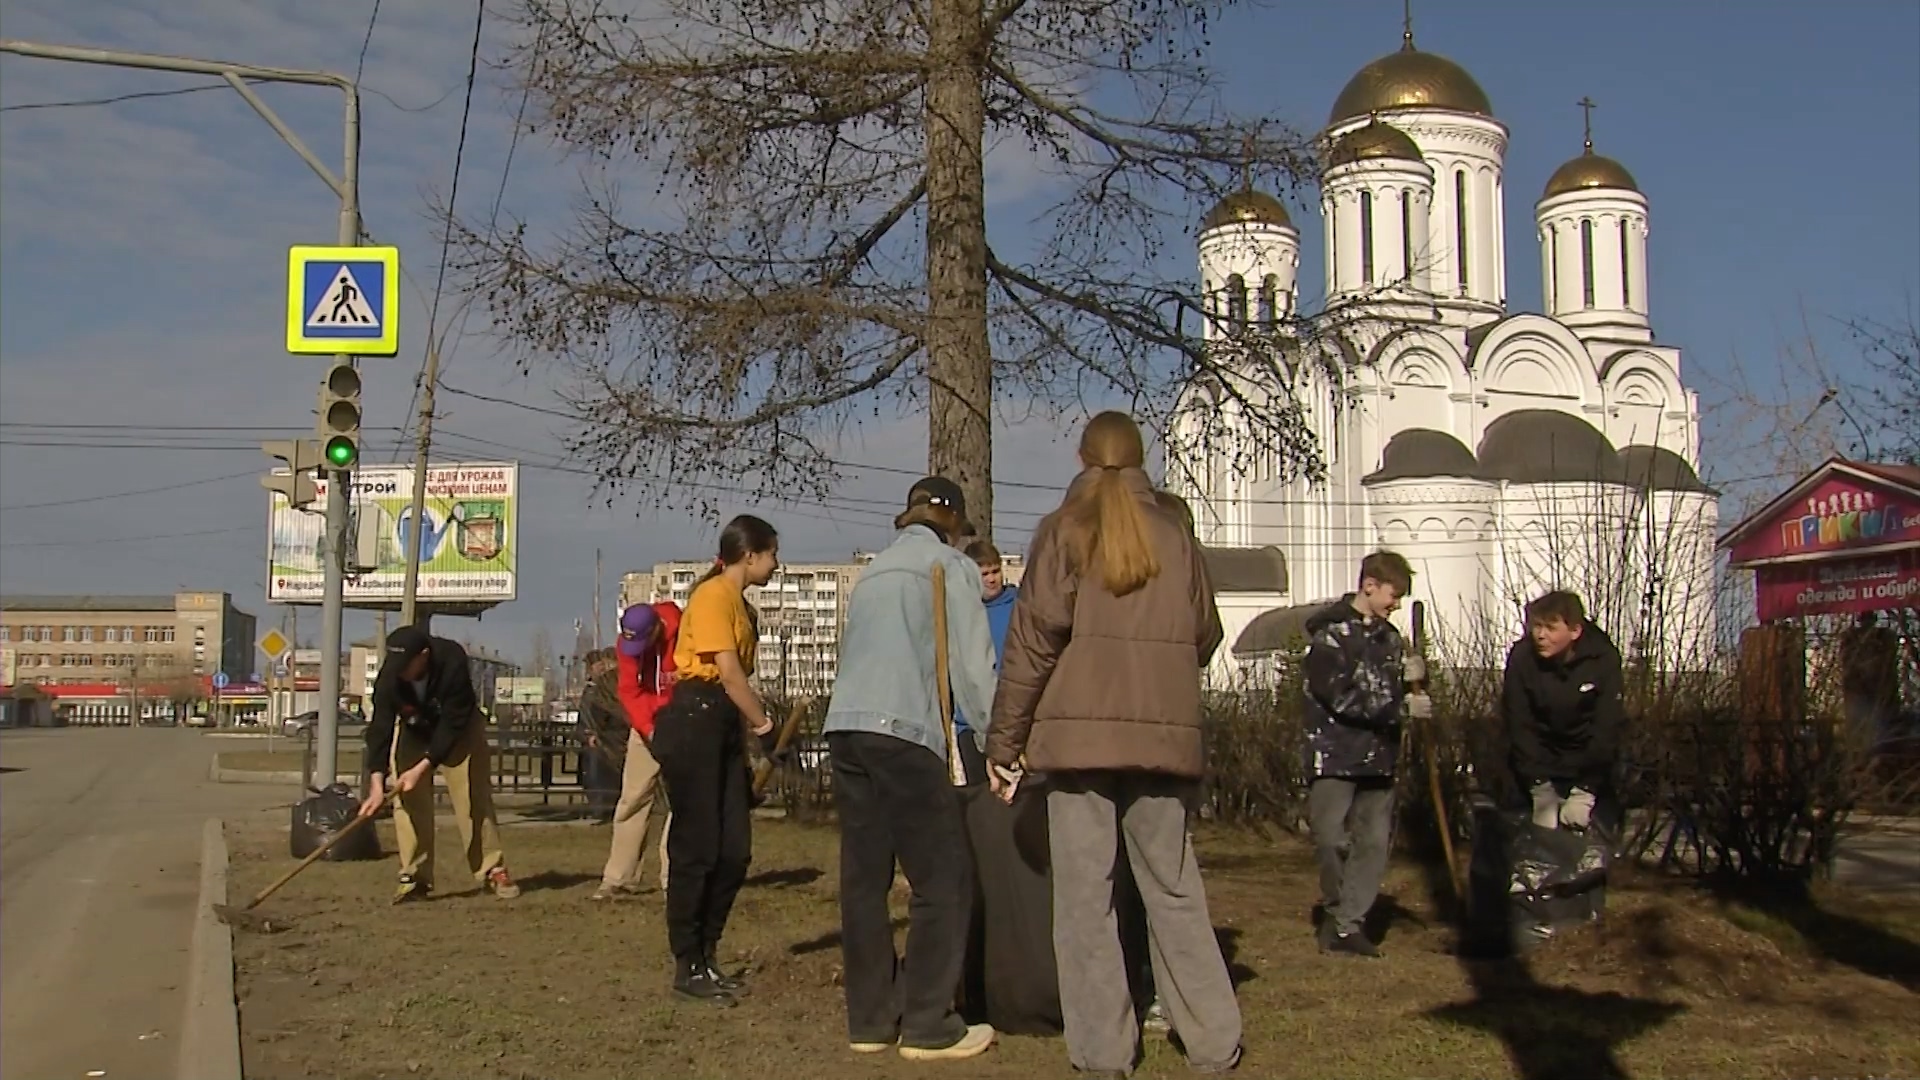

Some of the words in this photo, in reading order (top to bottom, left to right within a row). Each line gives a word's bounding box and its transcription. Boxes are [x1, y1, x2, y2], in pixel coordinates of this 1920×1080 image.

[437, 471, 458, 482] ДЛЯ
[460, 471, 504, 481] УРОЖАЯ
[472, 483, 508, 494] ЦЕНАМ
[1796, 585, 1857, 604] одежда
[1862, 586, 1873, 599] и
